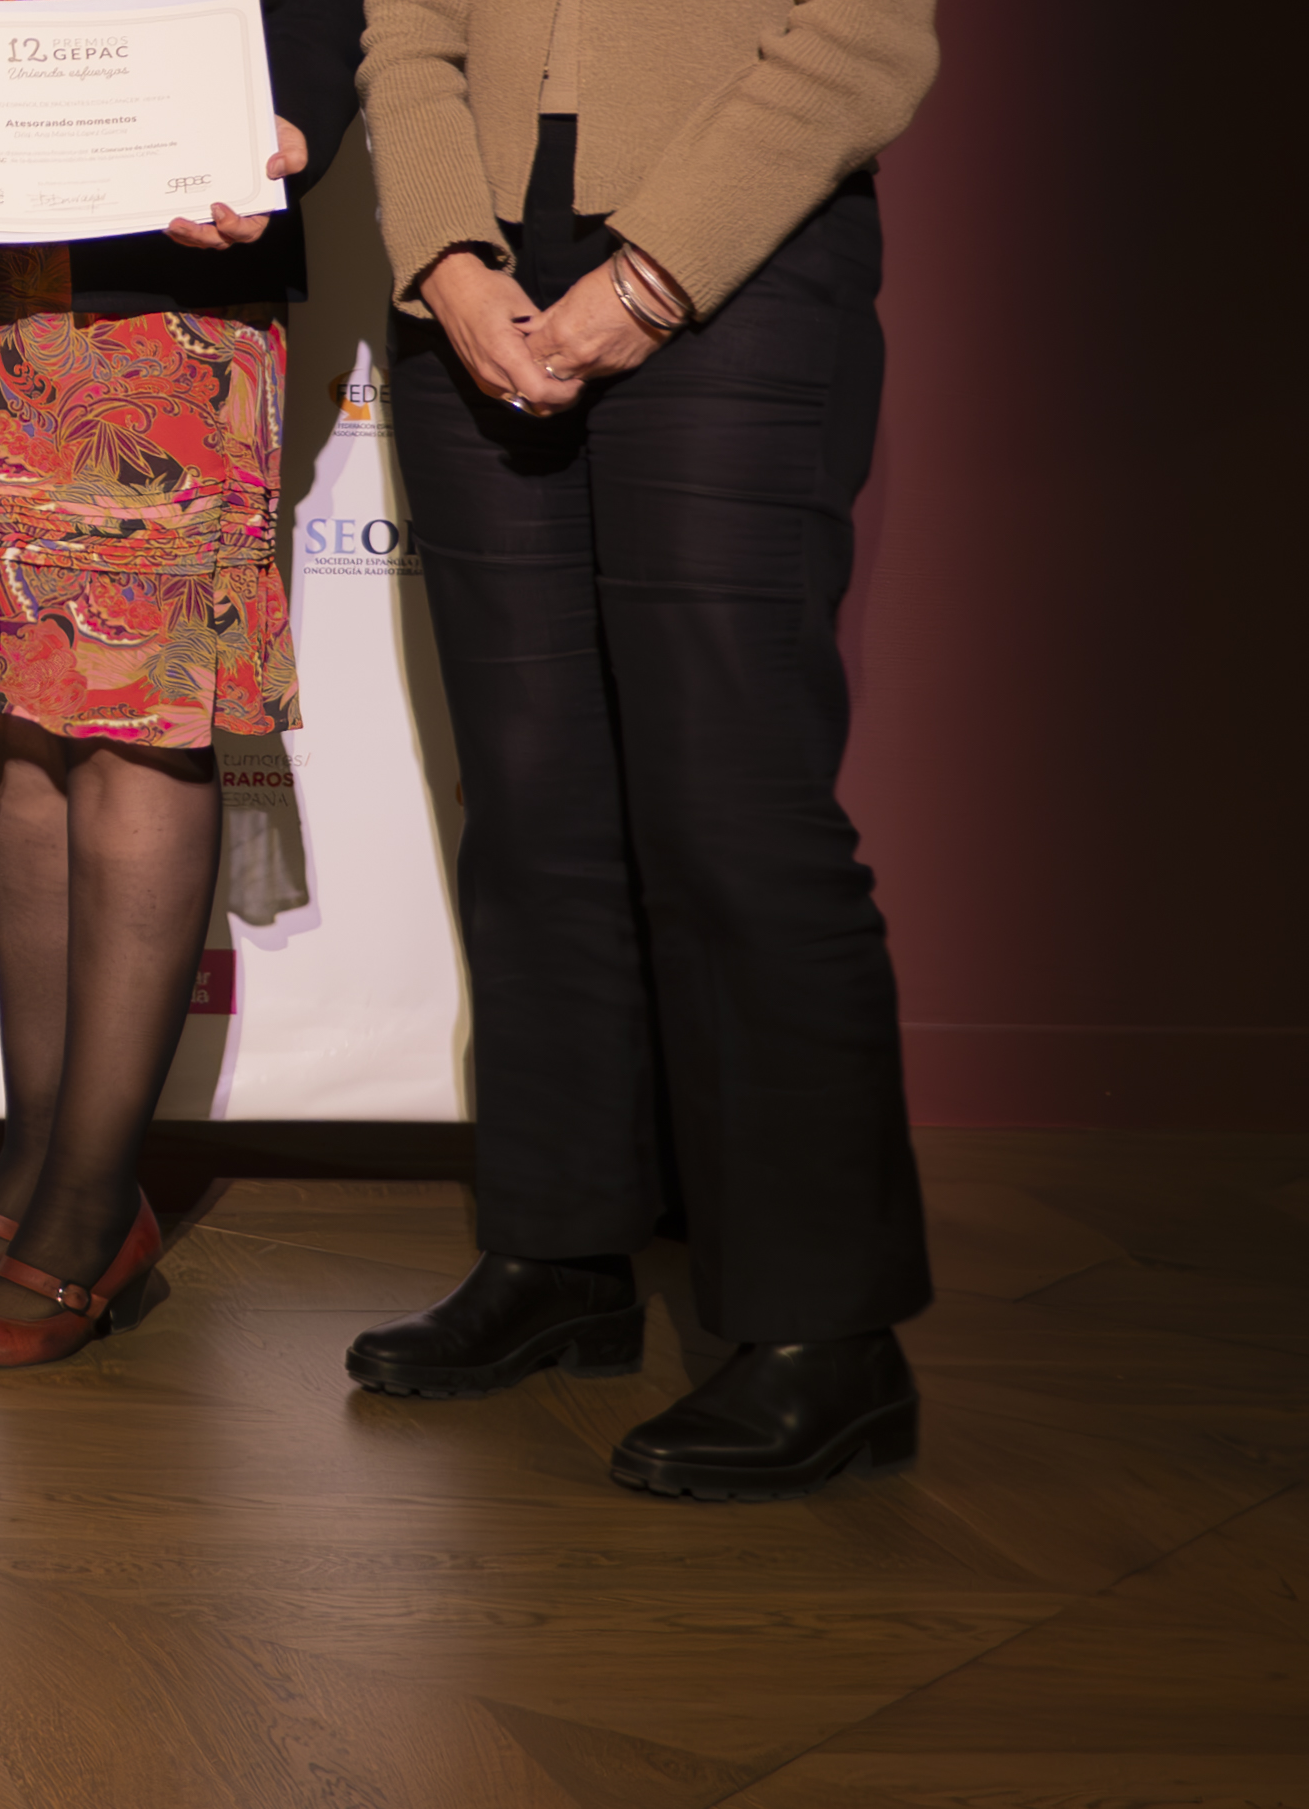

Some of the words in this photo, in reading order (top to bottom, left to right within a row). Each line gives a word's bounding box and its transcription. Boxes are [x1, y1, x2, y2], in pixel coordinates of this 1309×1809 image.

[52, 35, 130, 48] PREMIOS
[7, 37, 48, 63] 12
[52, 45, 129, 61] GEPAC
[7, 66, 67, 81] Uniendo
[68, 65, 131, 82] esfuerzos
[5, 118, 74, 128] Atesorando
[75, 115, 138, 127] momentos
[336, 383, 392, 404] FEDE
[314, 557, 363, 566] SOCIEDAD
[222, 771, 295, 788] RAROS
